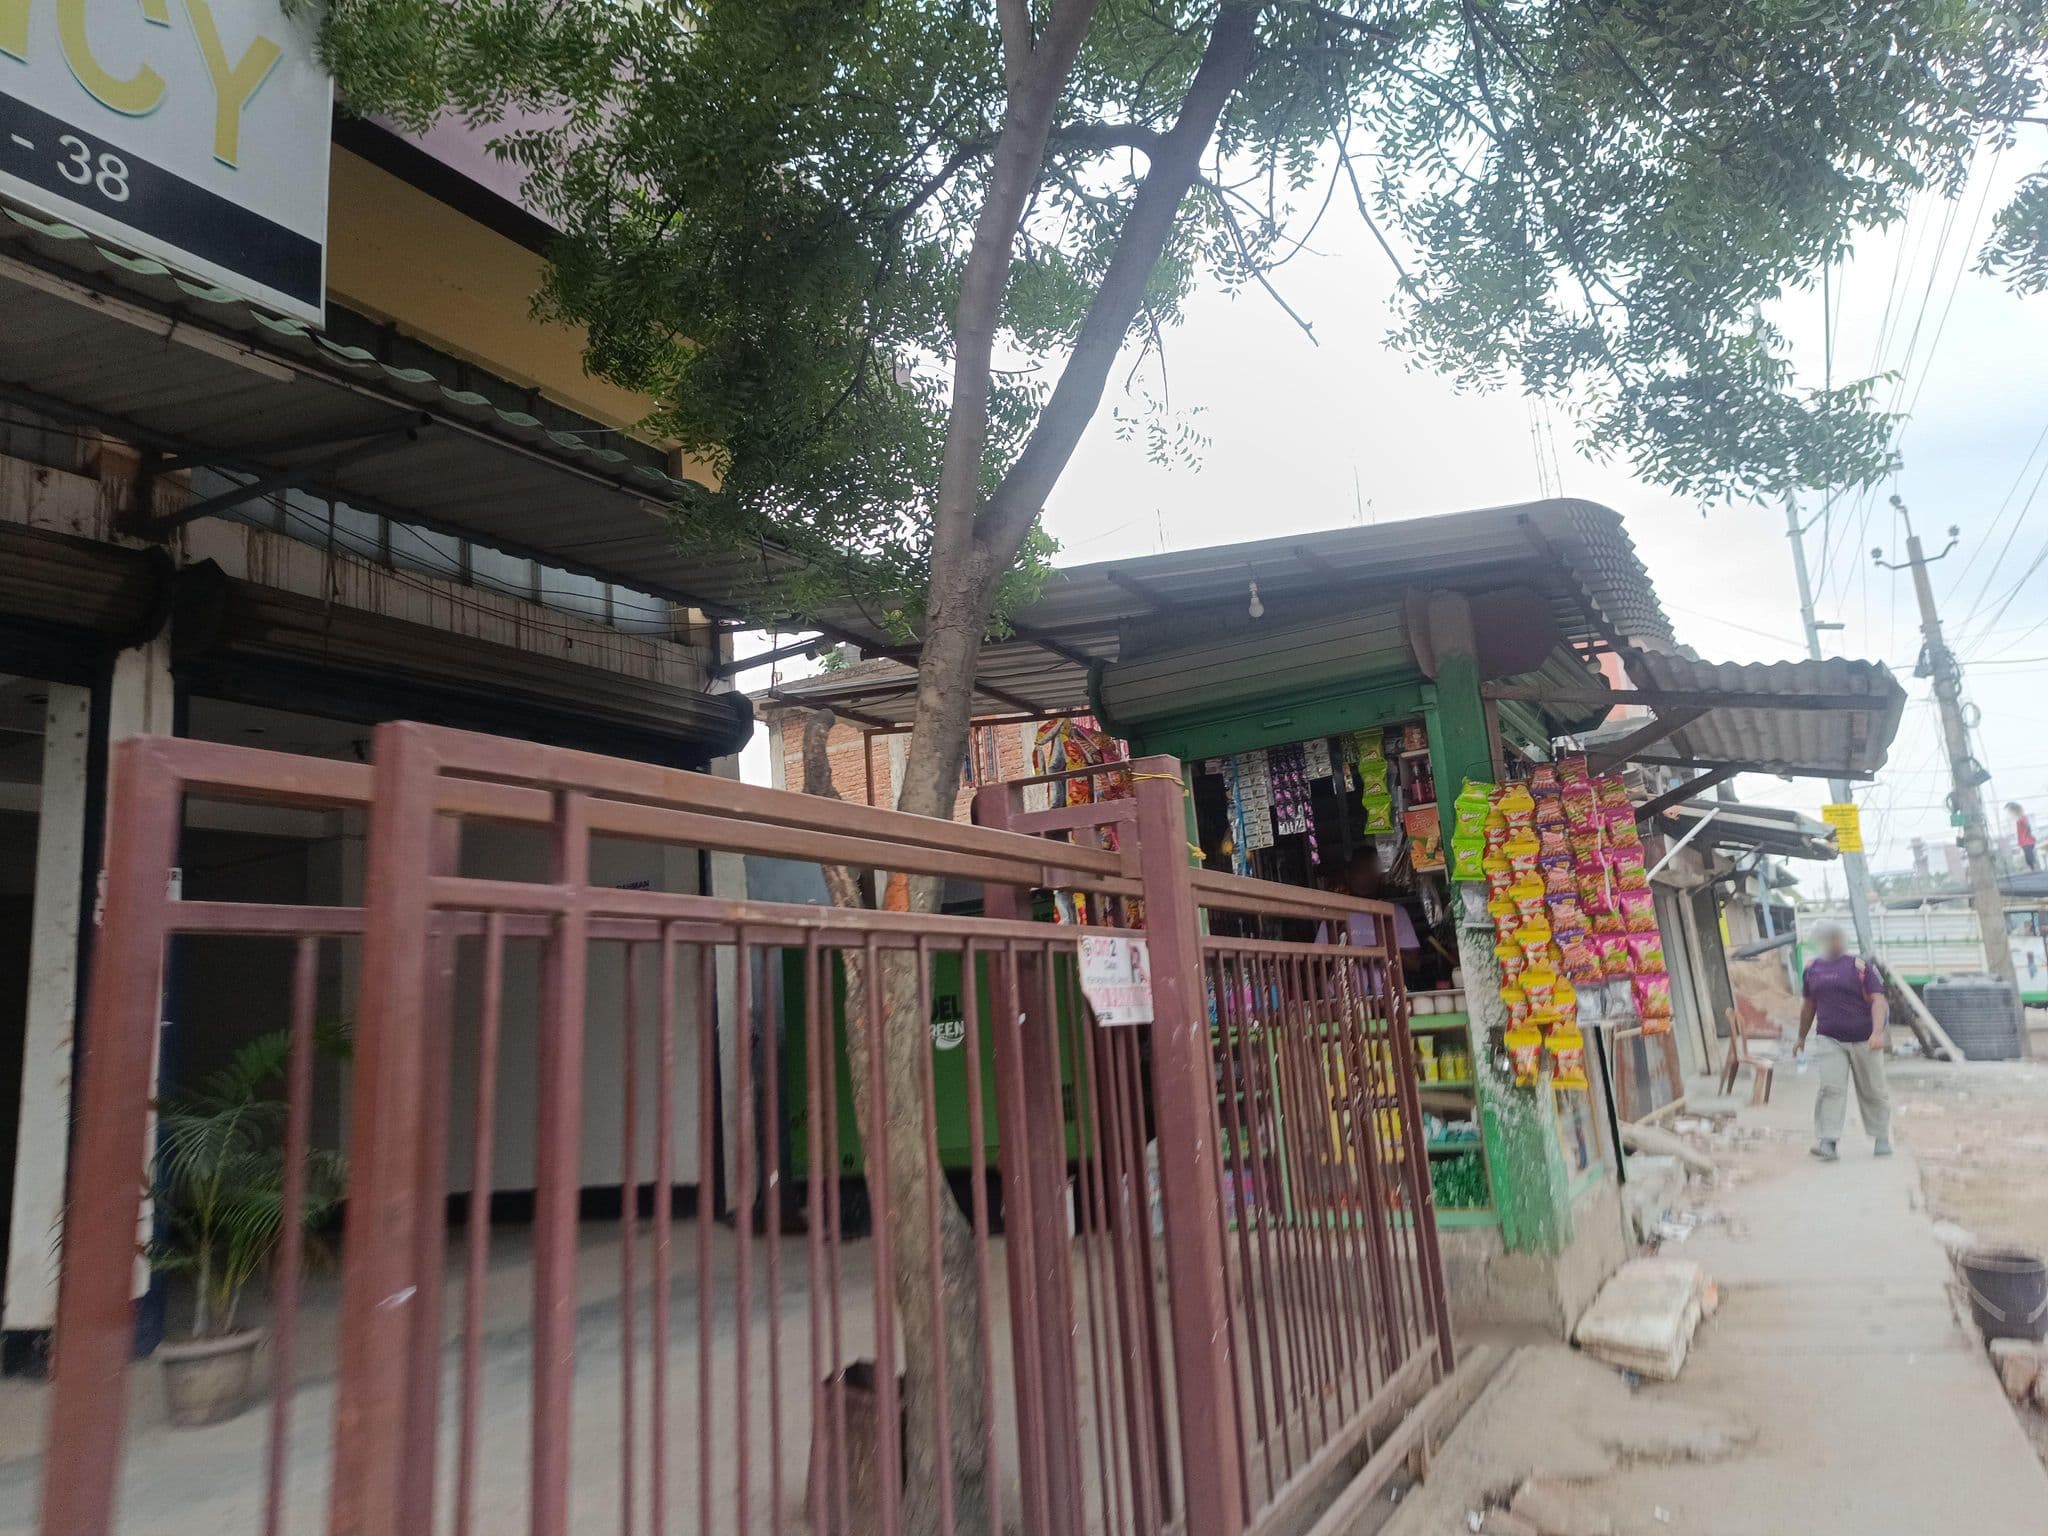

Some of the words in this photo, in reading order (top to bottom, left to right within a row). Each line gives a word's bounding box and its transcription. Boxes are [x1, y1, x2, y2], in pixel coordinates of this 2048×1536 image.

[0, 0, 282, 169] CY
[56, 135, 130, 202] 38
[928, 1020, 965, 1040] REEN
